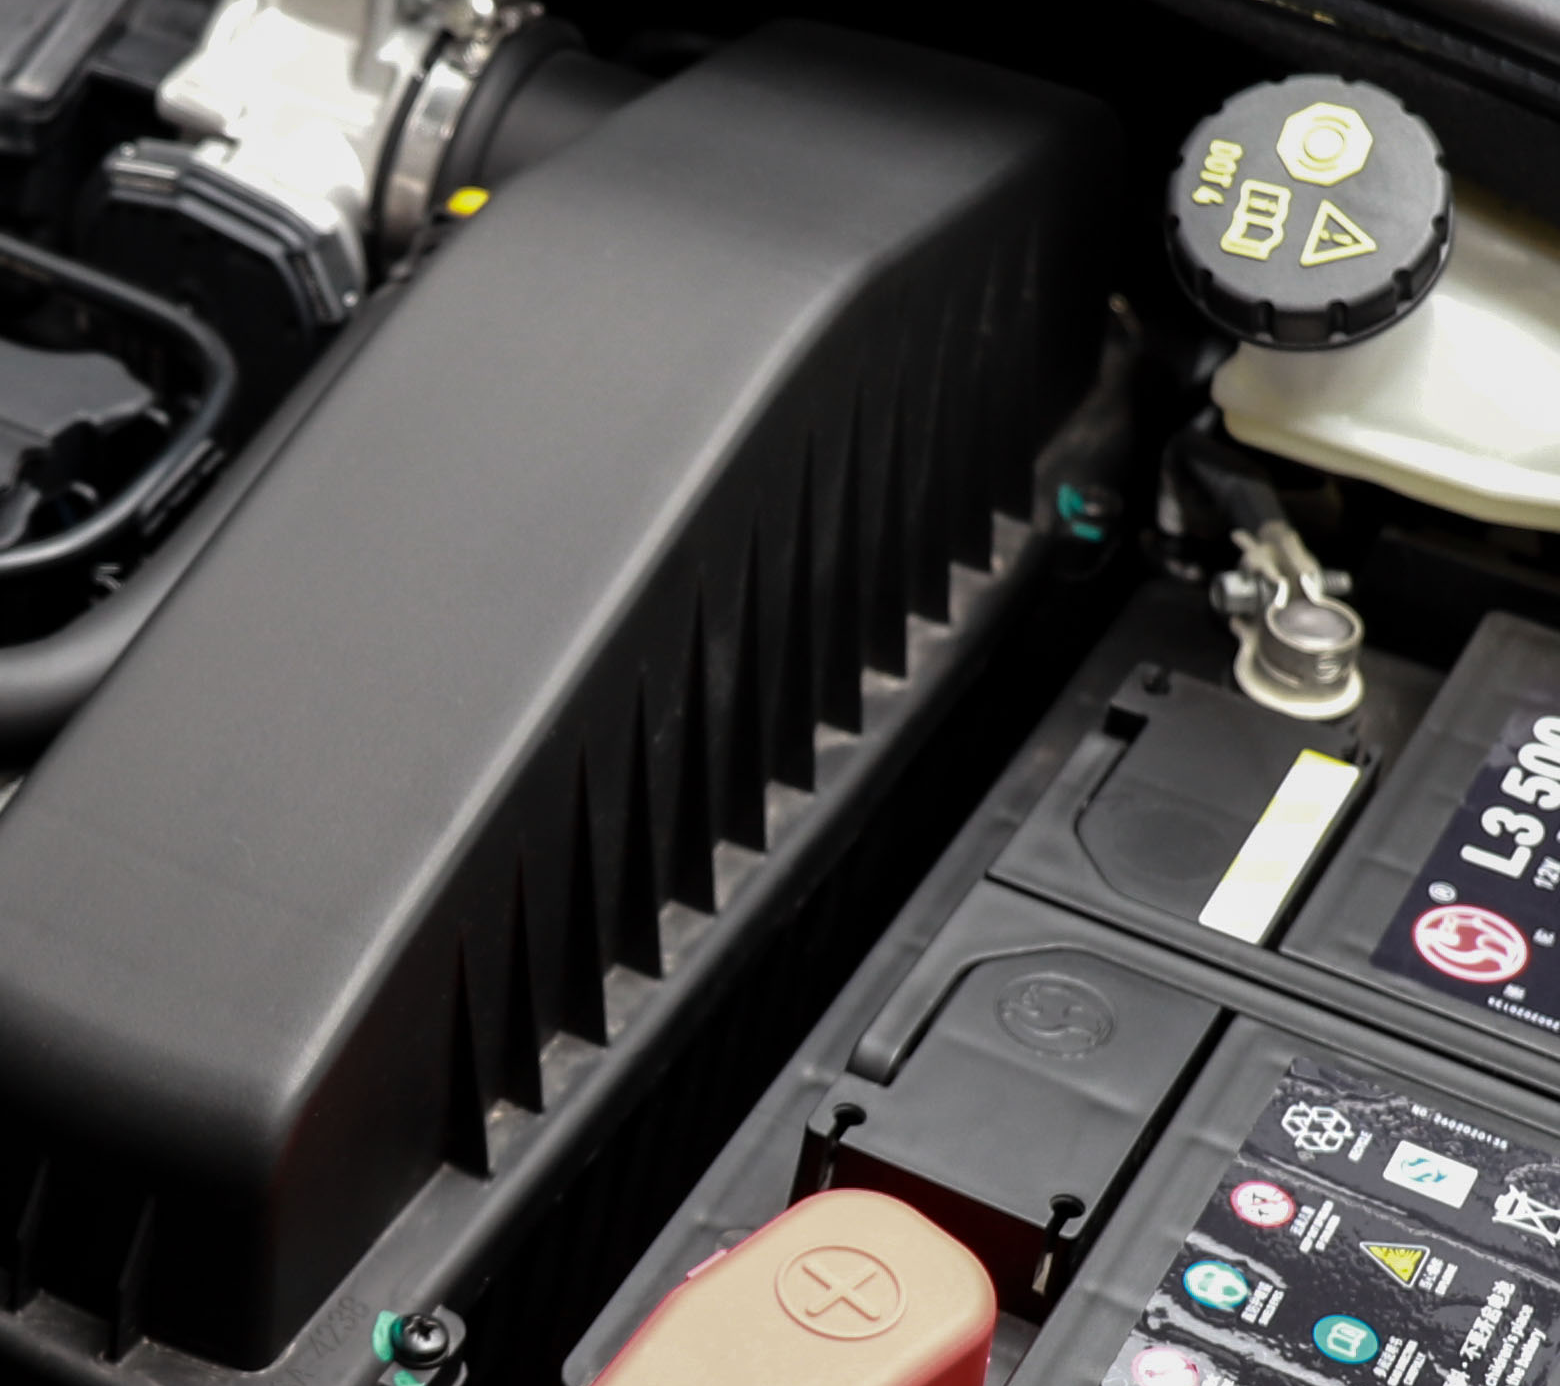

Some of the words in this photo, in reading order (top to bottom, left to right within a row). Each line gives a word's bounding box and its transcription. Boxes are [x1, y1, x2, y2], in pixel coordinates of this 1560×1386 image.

[1200, 139, 1243, 189] DOT
[1461, 807, 1544, 877] L3
[1485, 1334, 1518, 1386] children's
[1511, 1305, 1533, 1338] place
[1514, 1328, 1546, 1369] battery
[1506, 1366, 1525, 1386] the
